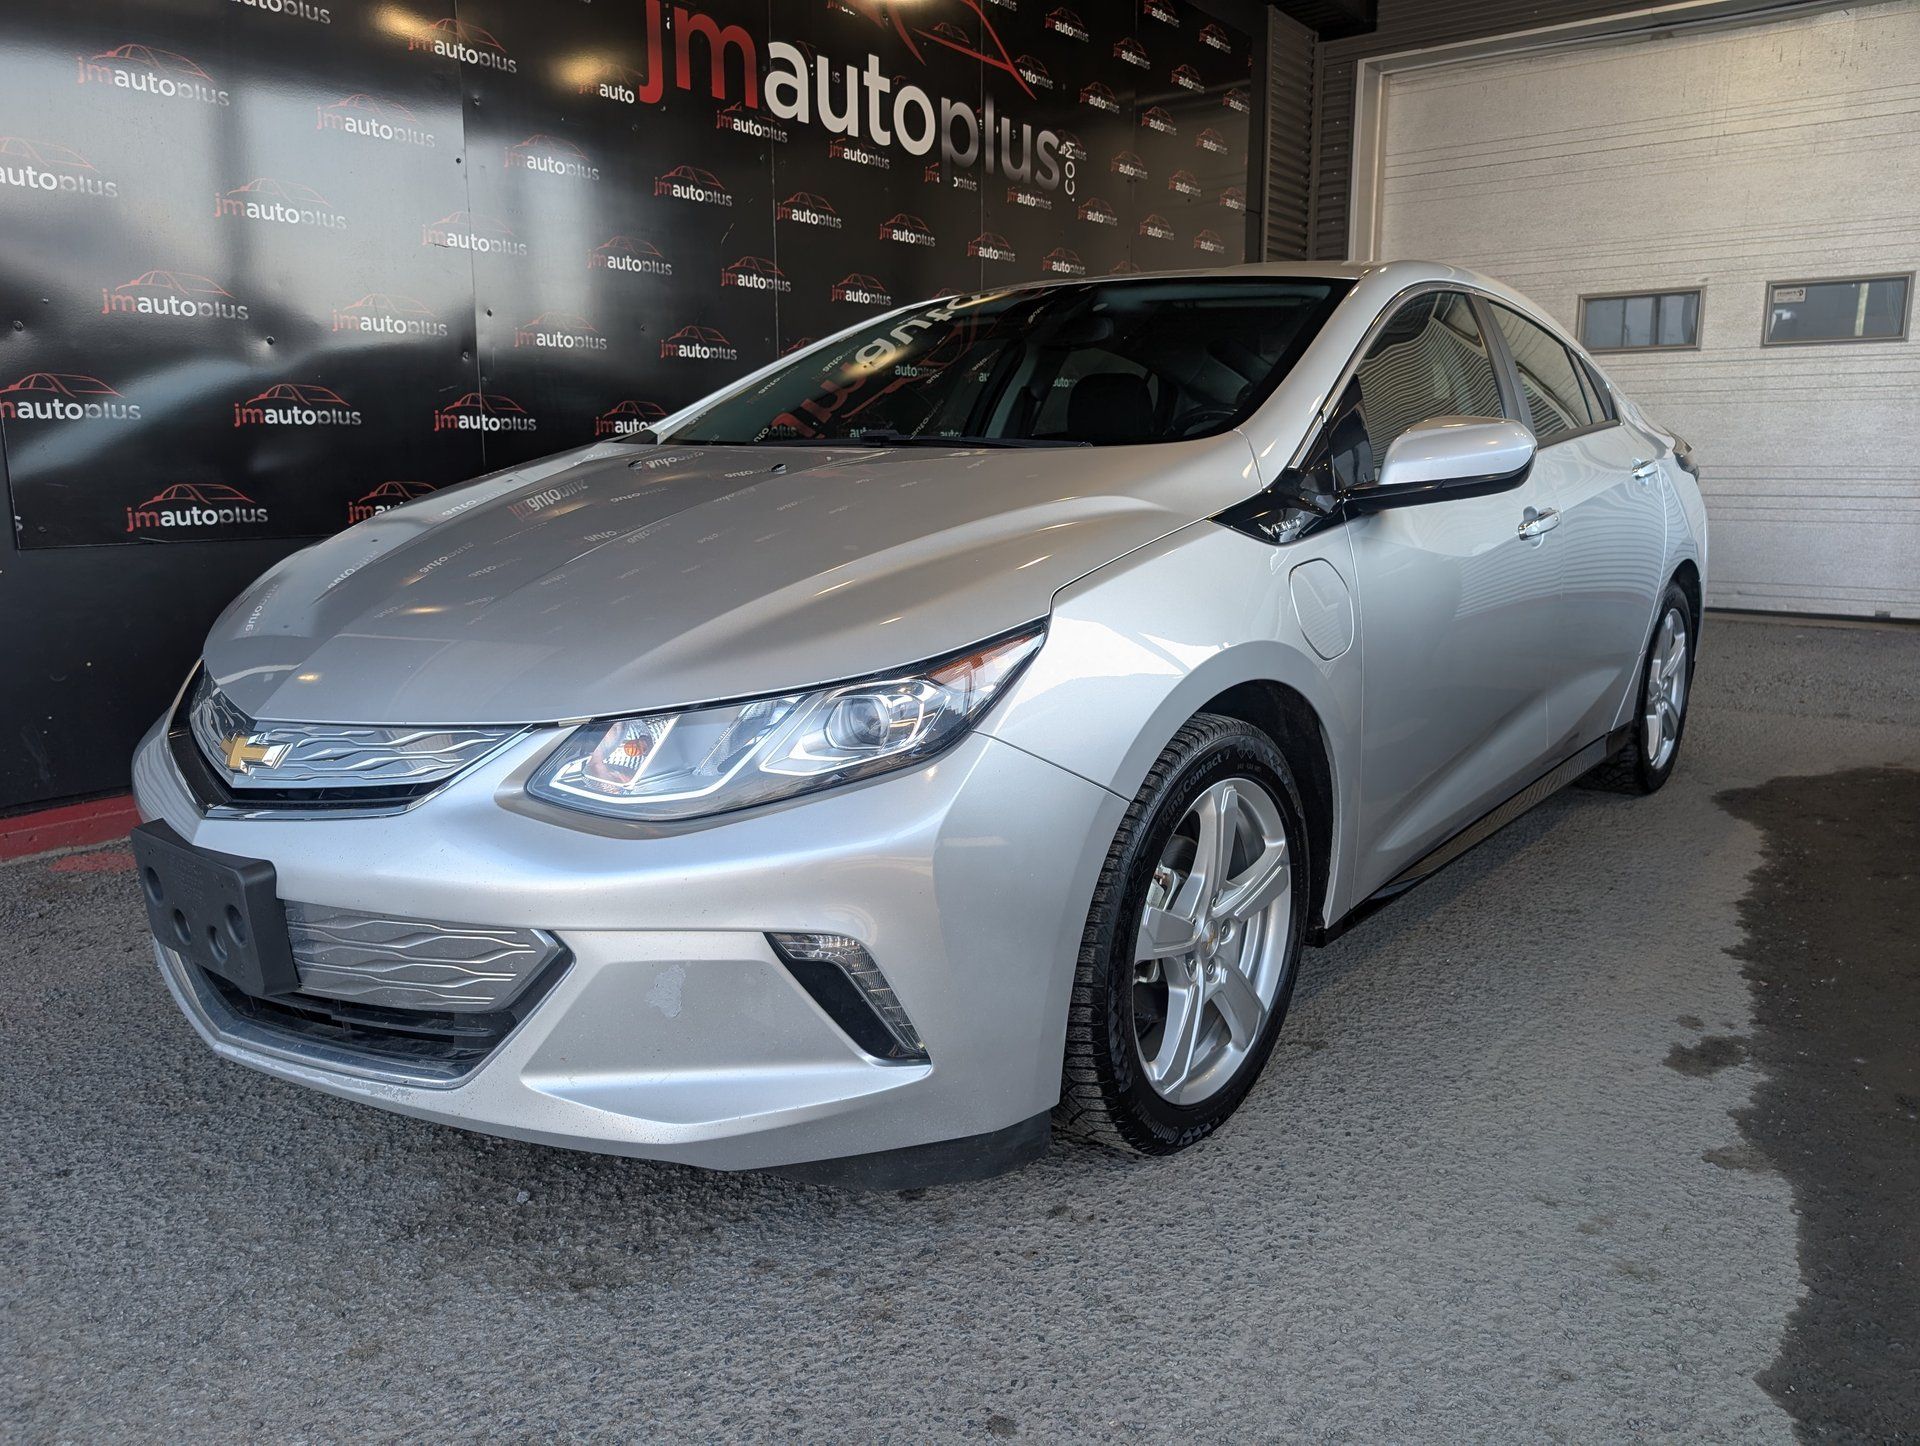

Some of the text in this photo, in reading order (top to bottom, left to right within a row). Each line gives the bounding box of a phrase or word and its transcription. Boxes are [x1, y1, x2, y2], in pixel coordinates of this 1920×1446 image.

[408, 38, 517, 73] jmautoplus
[76, 56, 230, 106] jmautoplus
[579, 80, 634, 104] jmauto
[639, 0, 1060, 190] jmautoplus
[653, 176, 732, 207] jmautoplus
[721, 268, 791, 292] jmautoplus
[101, 288, 249, 321] jmautoplus
[831, 285, 891, 306] jmautoplus
[332, 309, 447, 337] jmautoplus
[514, 327, 607, 351] jmautoplus
[660, 340, 737, 361] jmautoplus
[234, 403, 361, 427] jmautoplus
[434, 410, 536, 432] jmautoplus
[595, 416, 651, 436] jmauto
[126, 506, 268, 532] jmautoplus
